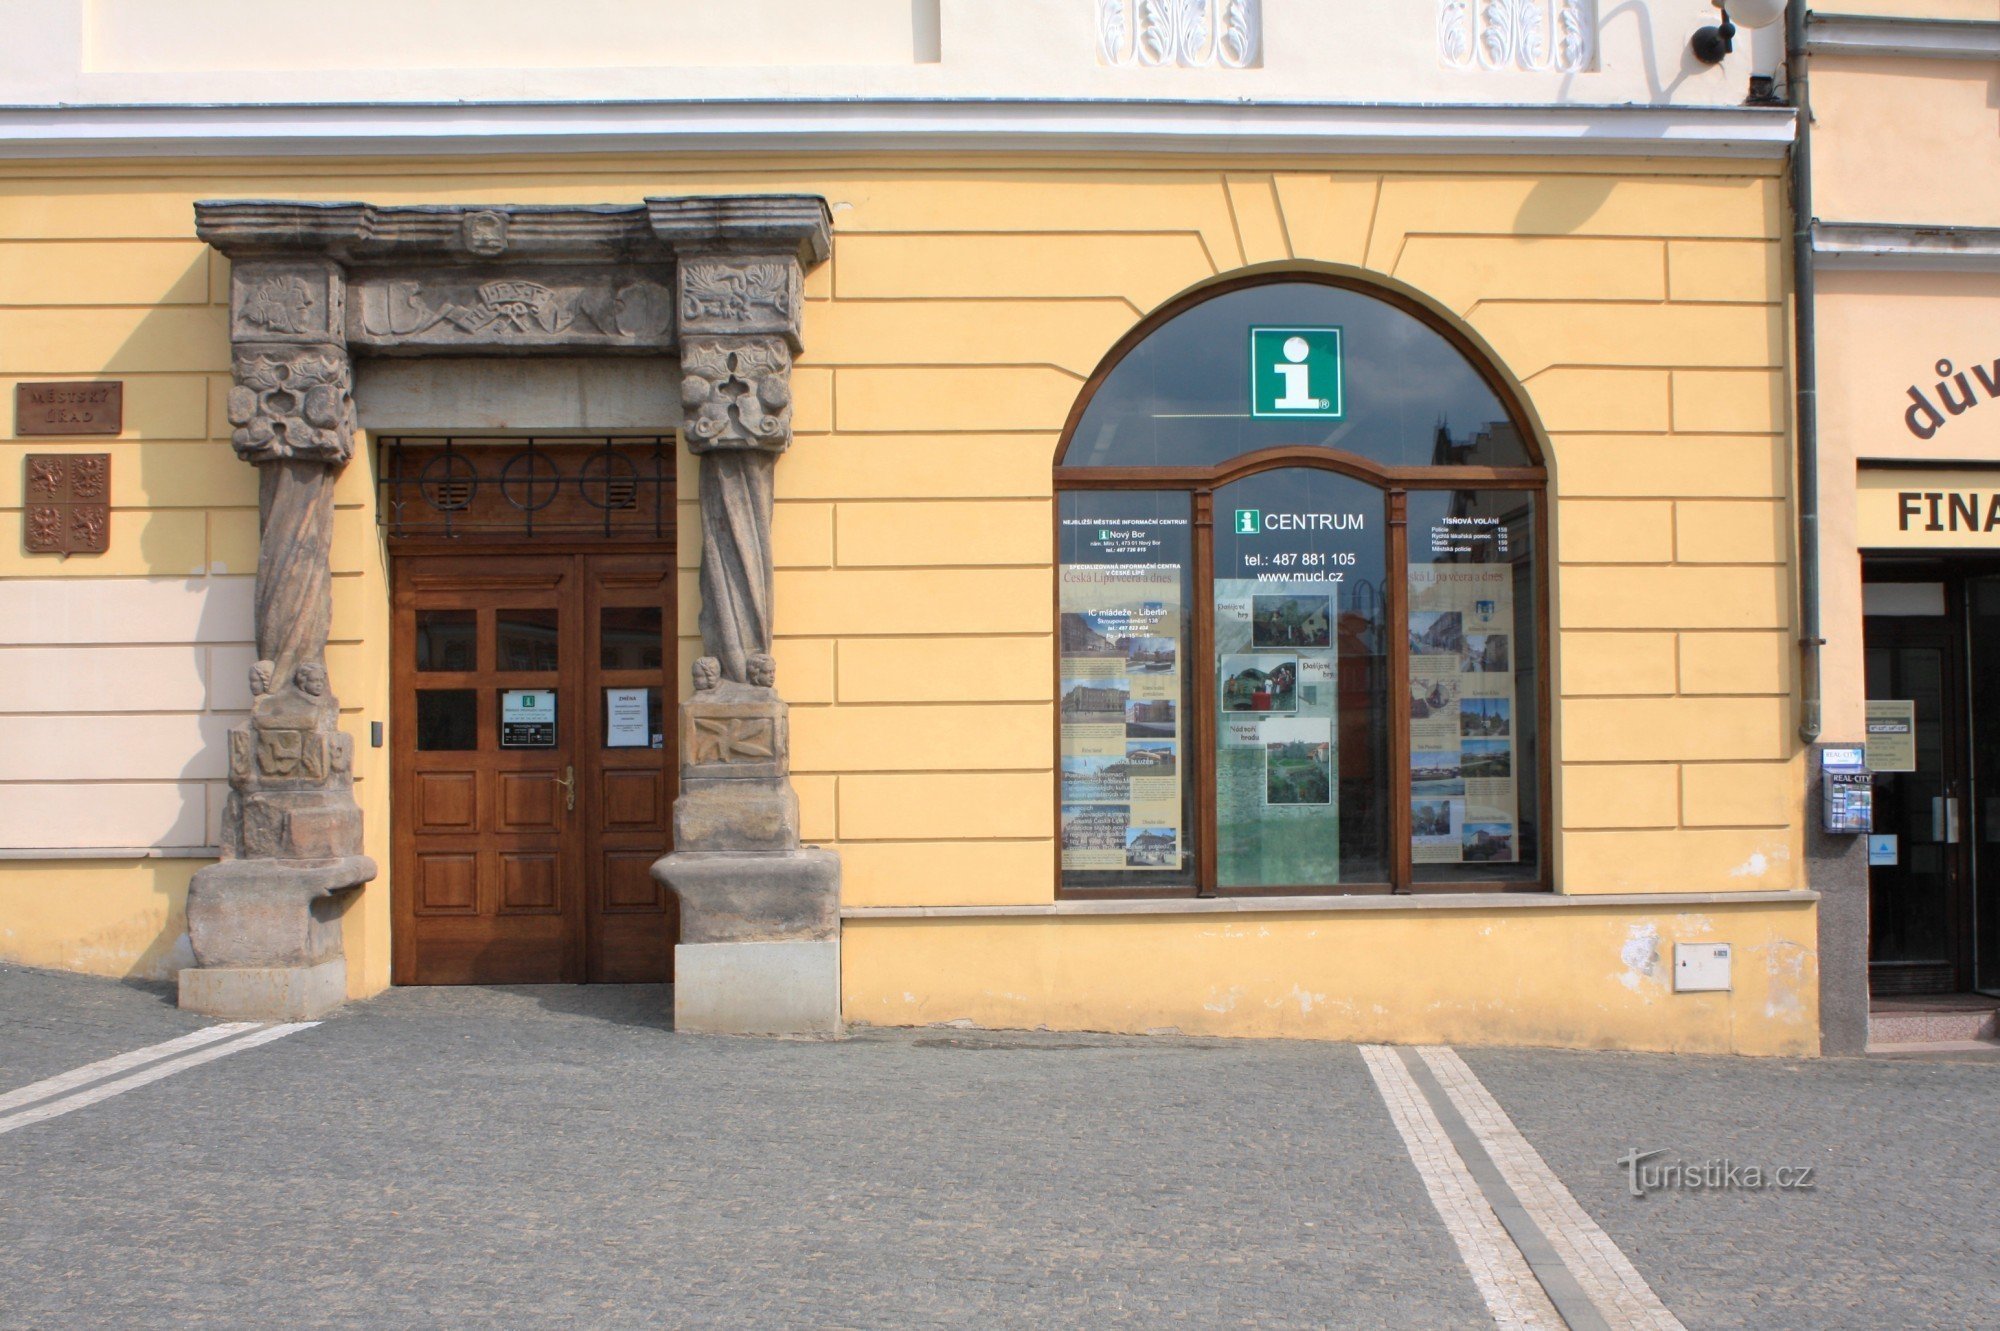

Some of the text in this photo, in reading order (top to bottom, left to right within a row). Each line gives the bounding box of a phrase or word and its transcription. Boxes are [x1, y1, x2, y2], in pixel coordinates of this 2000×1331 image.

[32, 389, 108, 403] MĚSTSKÝ
[1264, 514, 1364, 530] CENTRUM
[1110, 530, 1130, 539] Nový
[1132, 530, 1145, 538] Bor
[1244, 553, 1356, 566] tel.: 487 881 105
[1064, 571, 1091, 583] Česká
[1257, 570, 1344, 582] www.mucl.cz
[1482, 572, 1503, 582] dnes
[1833, 774, 1871, 782] REAL-CITY
